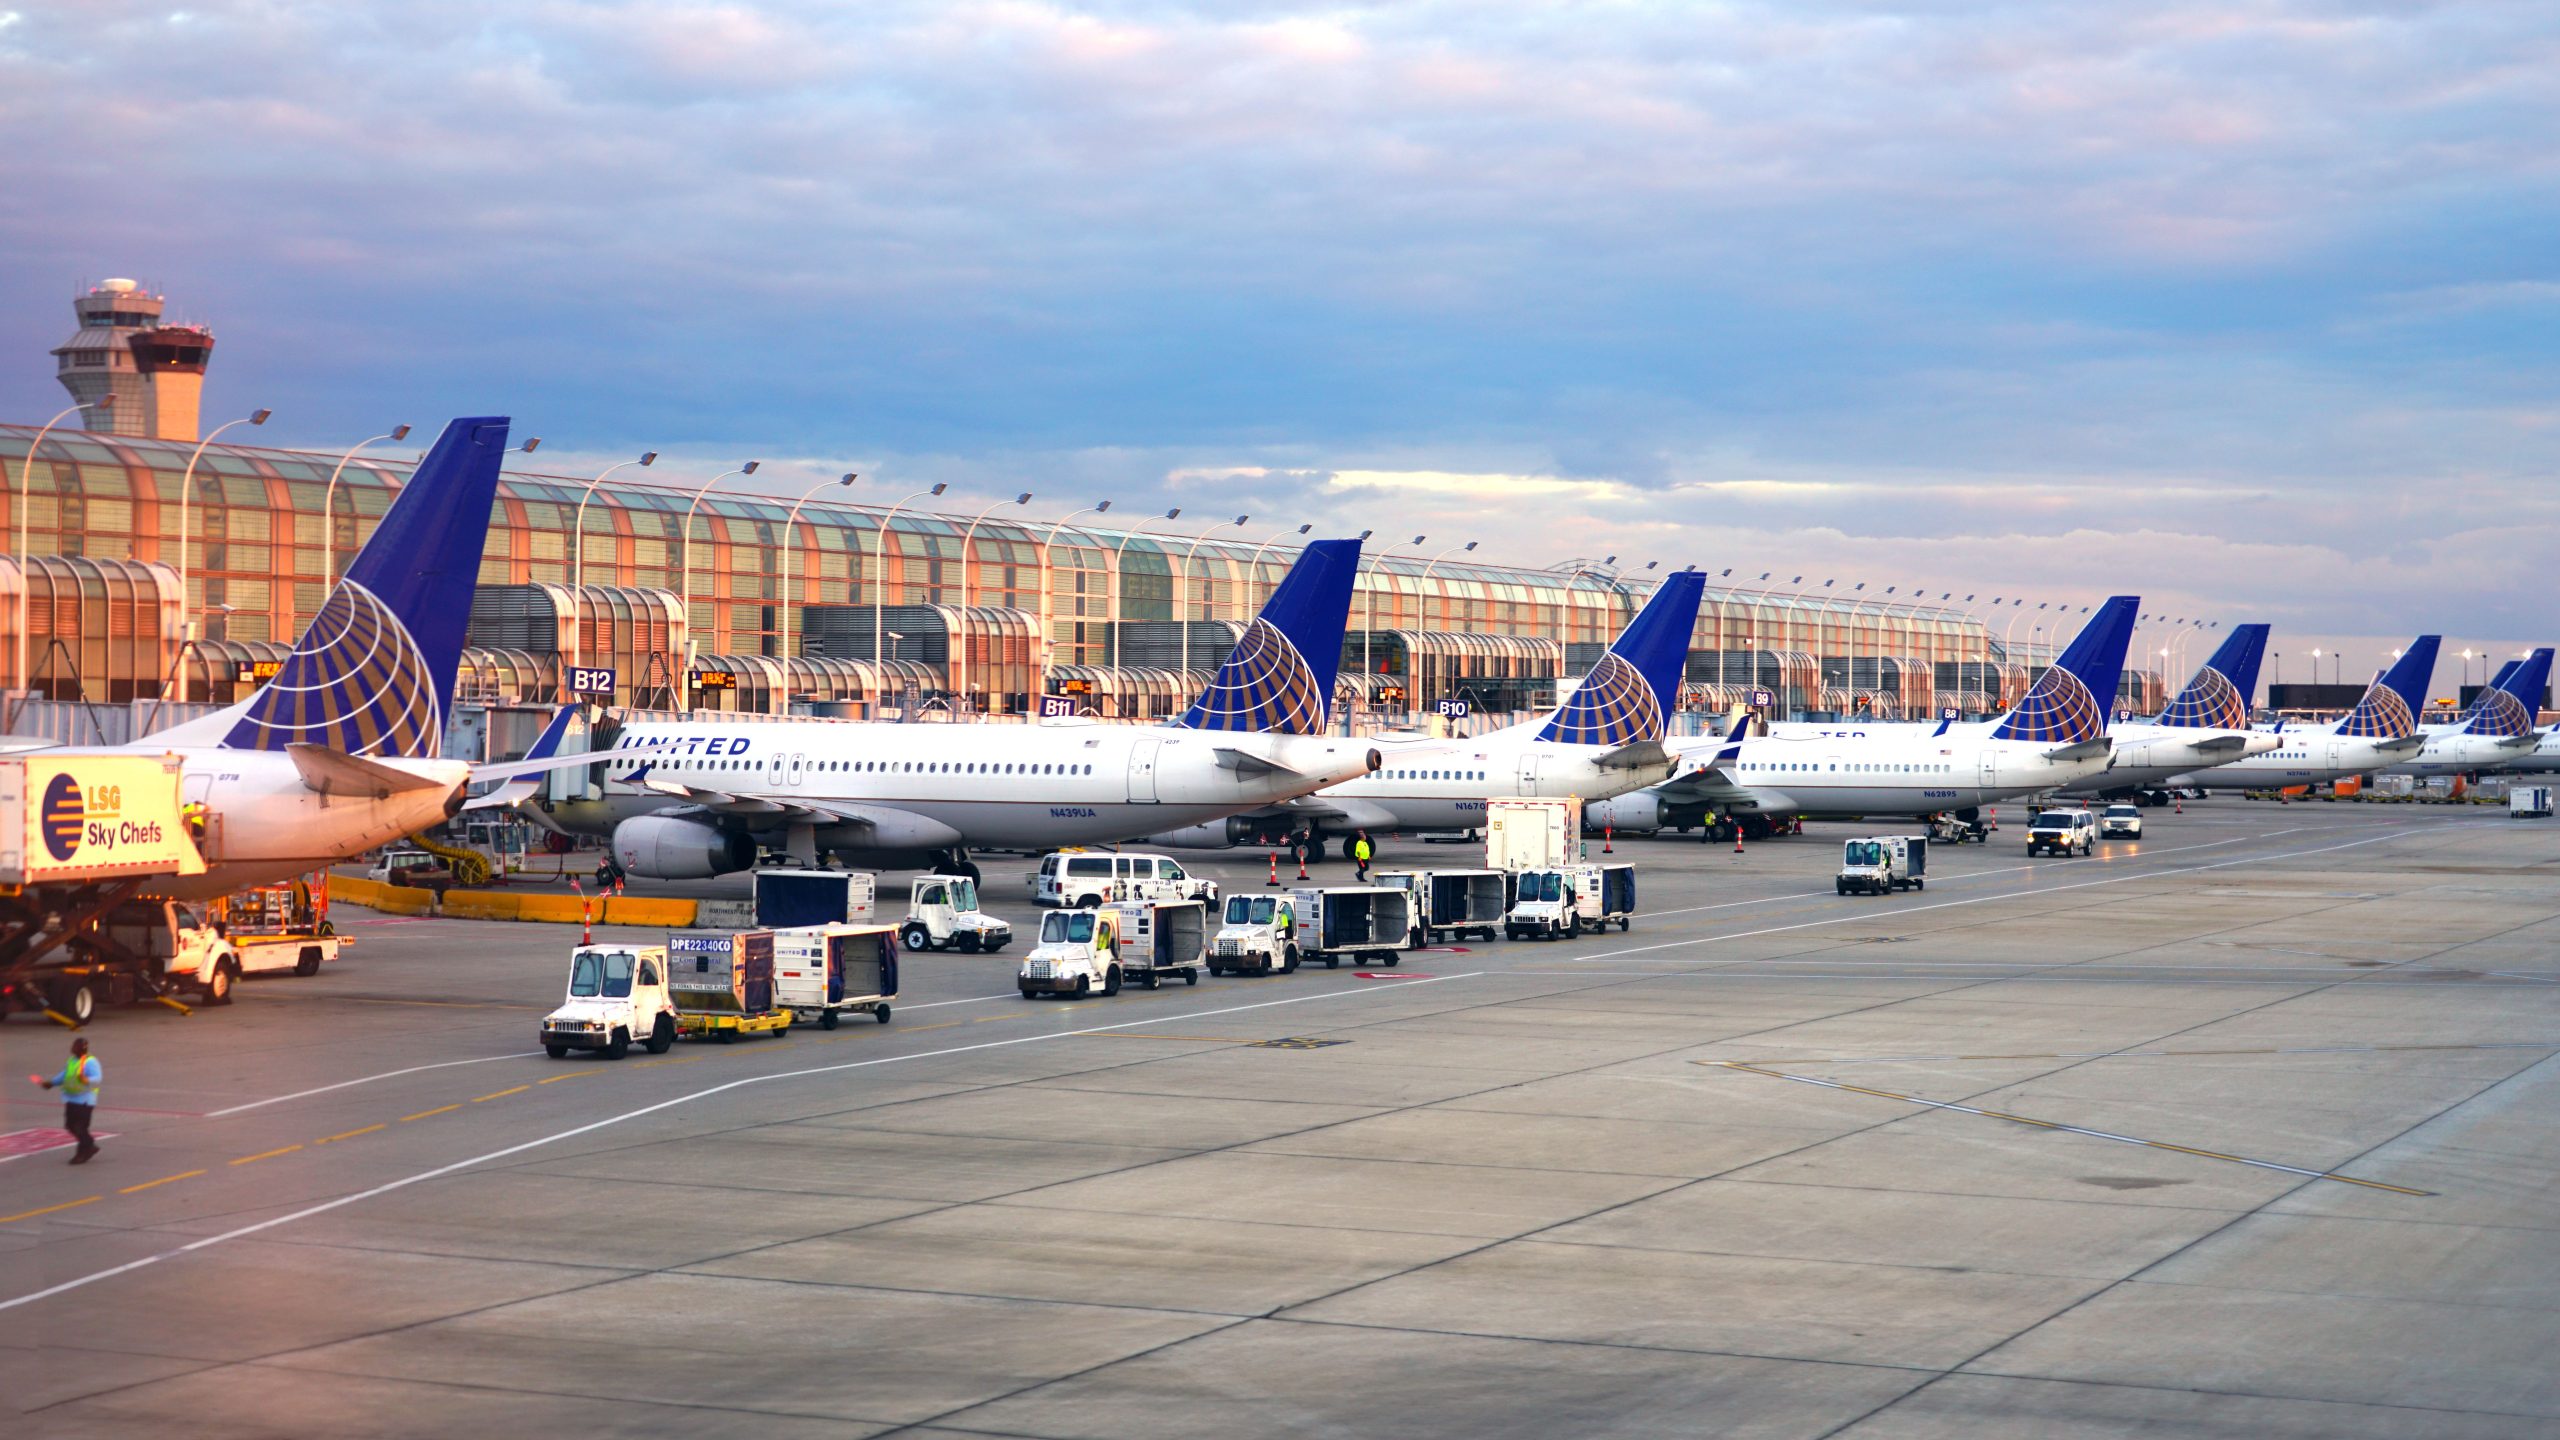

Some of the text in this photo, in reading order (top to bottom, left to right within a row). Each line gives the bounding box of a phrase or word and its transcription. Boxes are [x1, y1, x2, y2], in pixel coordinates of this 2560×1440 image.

[574, 670, 611, 691] B12
[1756, 693, 1769, 705] B9
[1045, 699, 1070, 717] B11
[1439, 701, 1466, 715] B10
[1944, 709, 1957, 718] B8
[2120, 711, 2130, 720] B7
[622, 736, 751, 755] UNITED
[88, 785, 121, 811] LSG
[1455, 802, 1486, 810] N1670
[1050, 808, 1096, 818] N439UA
[88, 821, 162, 850] Sky Chefs
[671, 939, 731, 952] DPE22340CO
